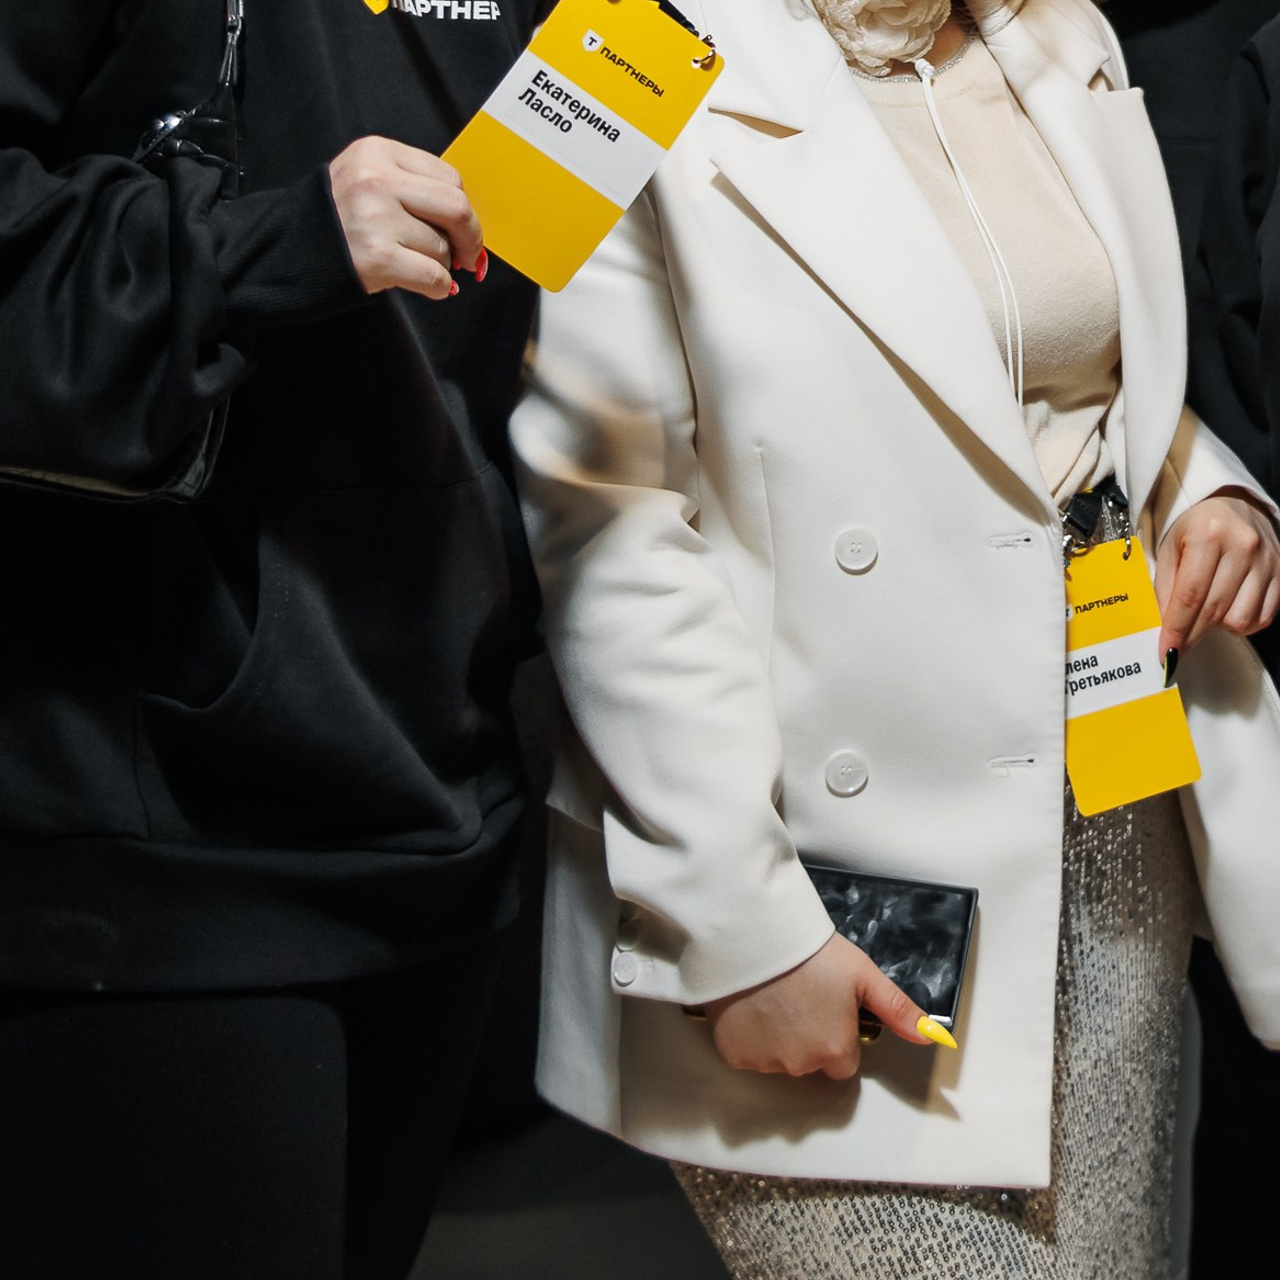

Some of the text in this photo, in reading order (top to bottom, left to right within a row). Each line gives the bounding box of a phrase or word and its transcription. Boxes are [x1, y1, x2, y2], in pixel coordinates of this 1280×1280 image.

[600, 46, 665, 98] ПАРТНЕРЫ
[518, 87, 573, 134] Ласло
[531, 69, 621, 143] Екатерина
[1074, 593, 1129, 614] ПАРТНЕРЫ
